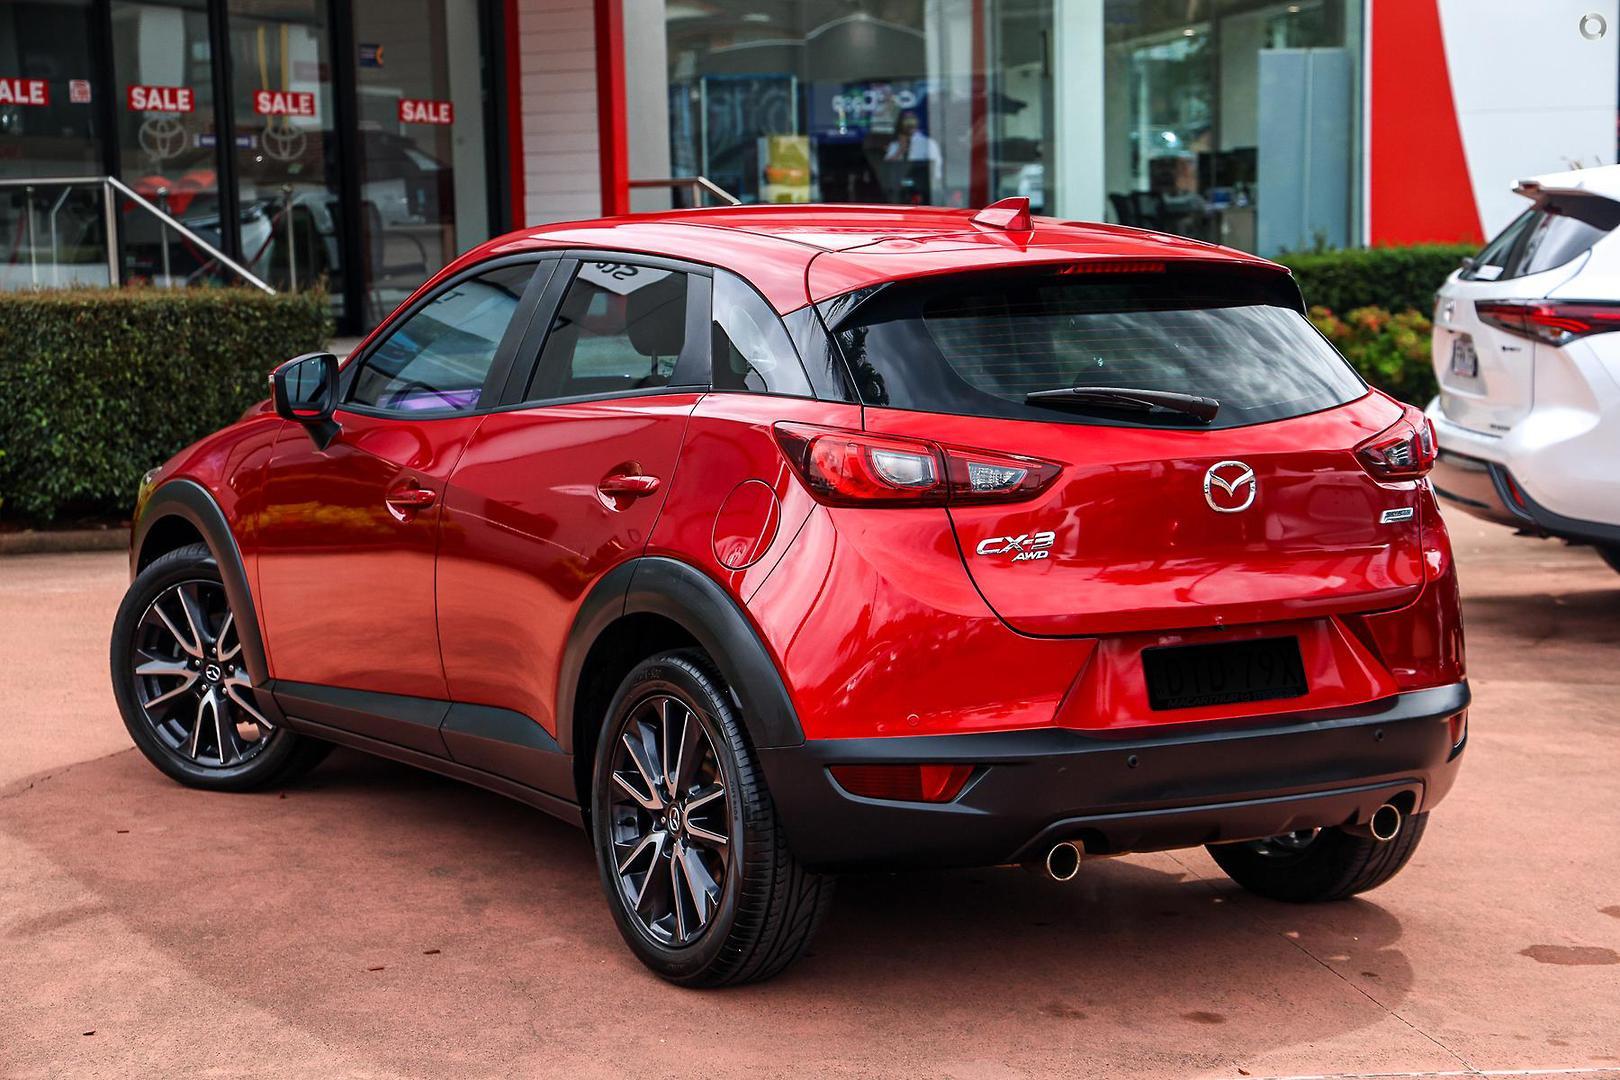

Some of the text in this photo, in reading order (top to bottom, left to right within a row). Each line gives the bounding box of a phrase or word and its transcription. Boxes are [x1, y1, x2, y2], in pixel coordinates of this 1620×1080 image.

[131, 87, 191, 111] SALE
[256, 92, 312, 116] SALE
[401, 100, 451, 123] SALE
[976, 531, 1056, 555] CX-3
[1011, 550, 1049, 563] AWD
